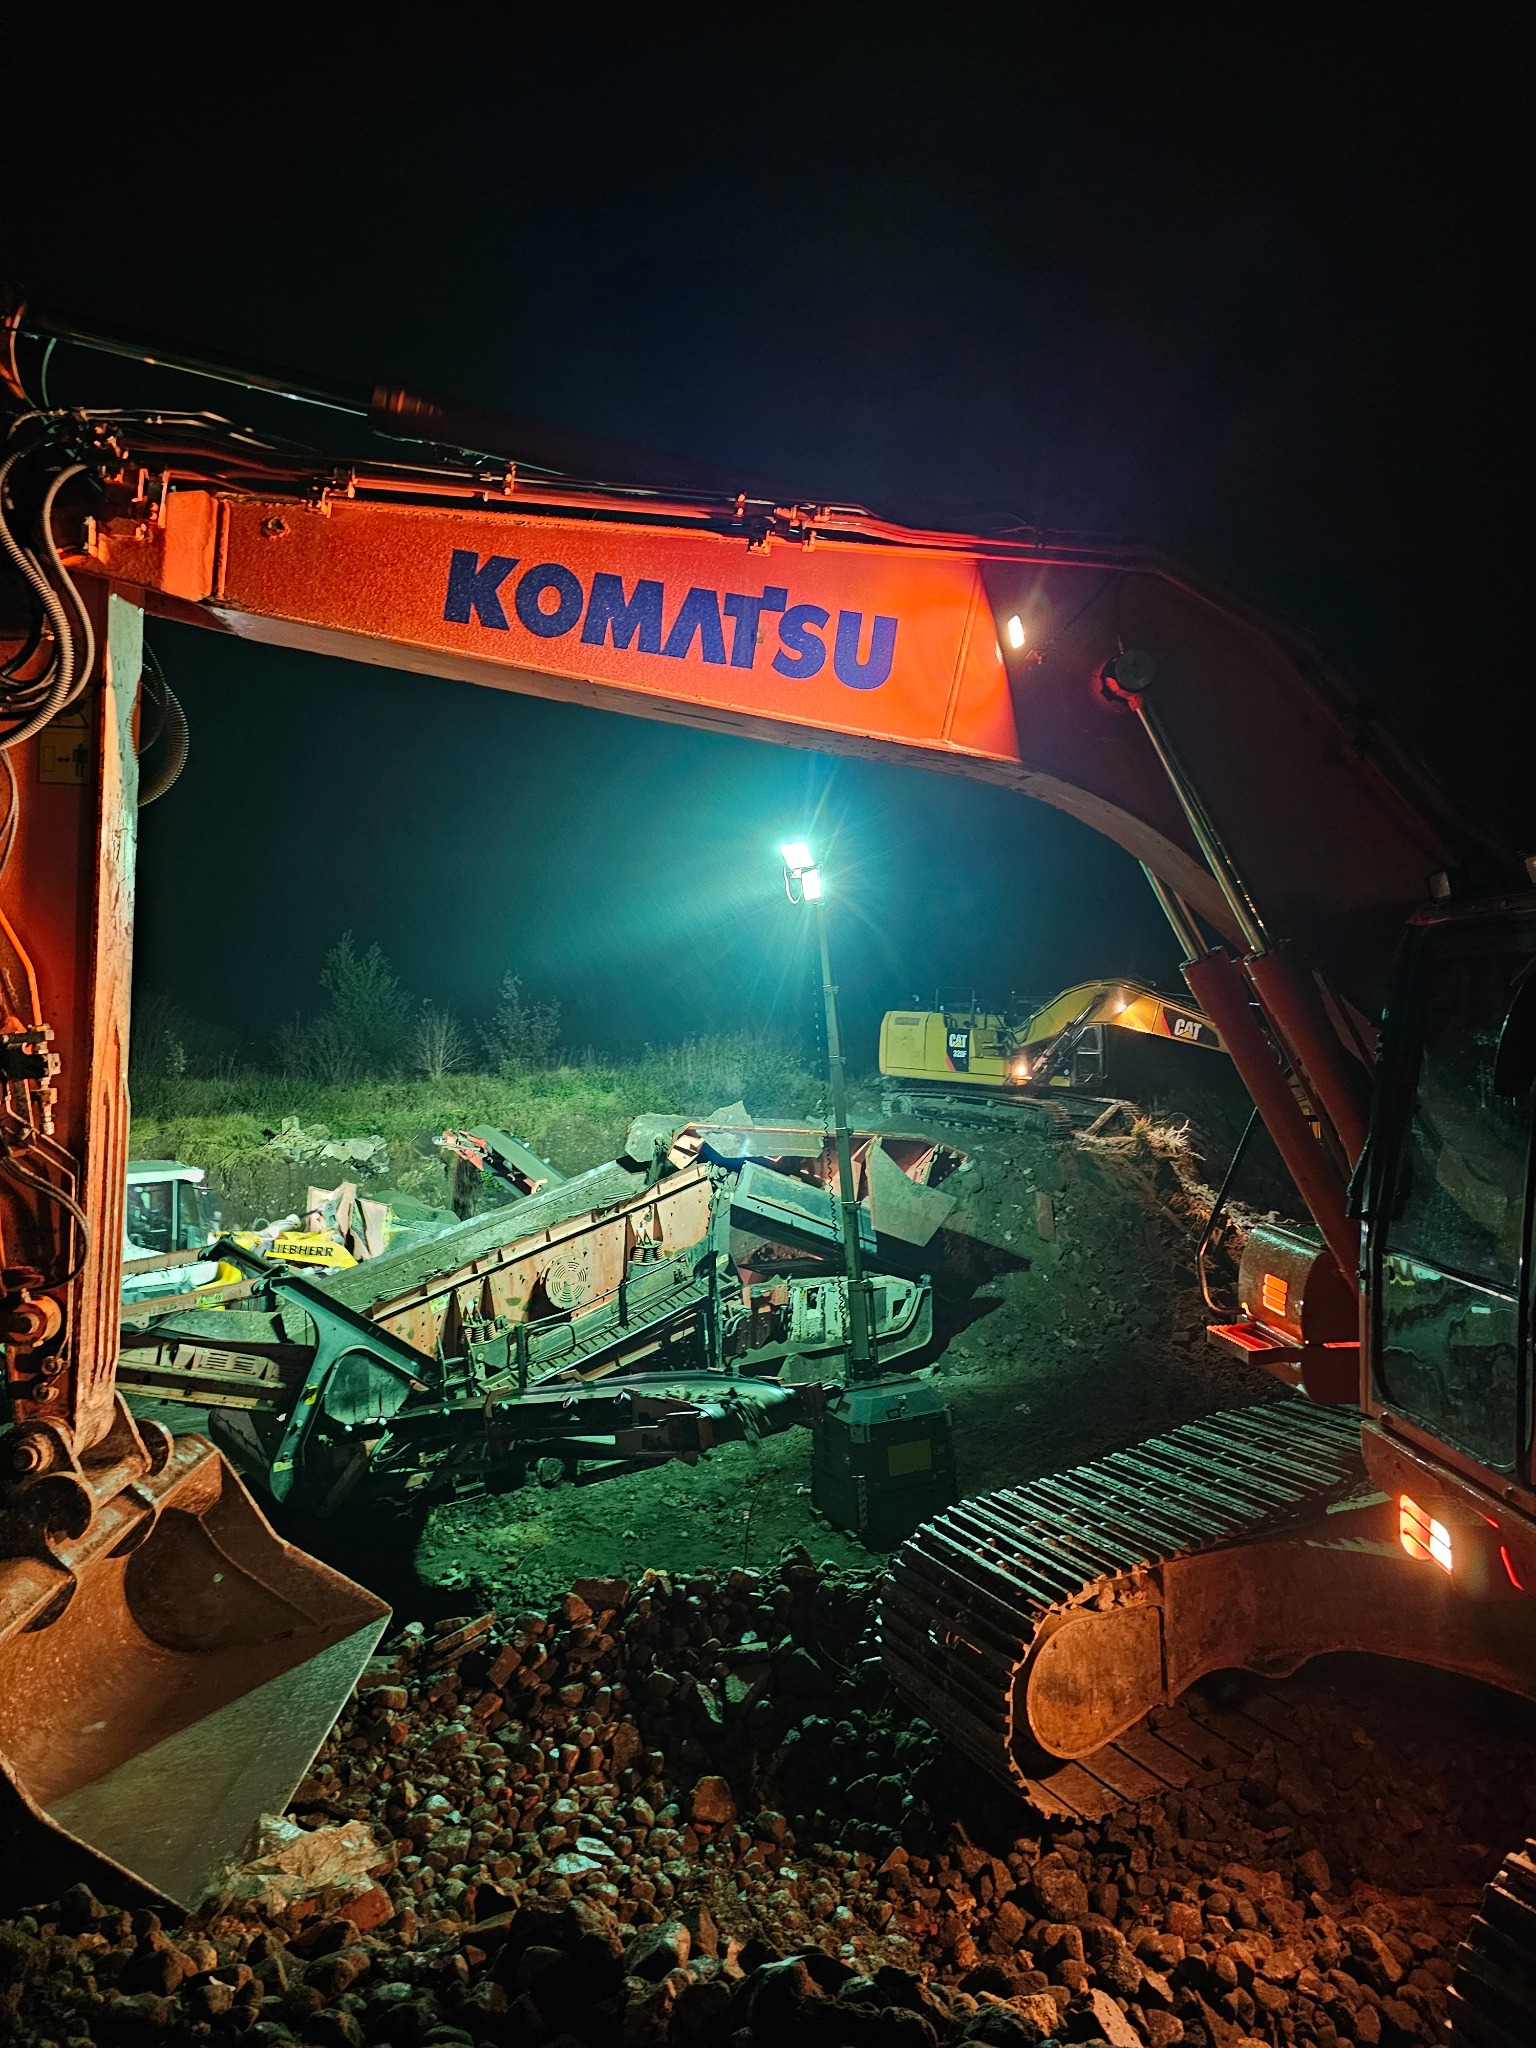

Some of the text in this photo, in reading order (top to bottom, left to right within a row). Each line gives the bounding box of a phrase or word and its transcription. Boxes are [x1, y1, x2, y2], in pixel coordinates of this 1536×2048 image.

[443, 548, 898, 690] KOMATSU
[1174, 1019, 1202, 1040] CAT
[949, 1034, 968, 1048] CAT
[276, 1244, 333, 1257] IEBHERR
